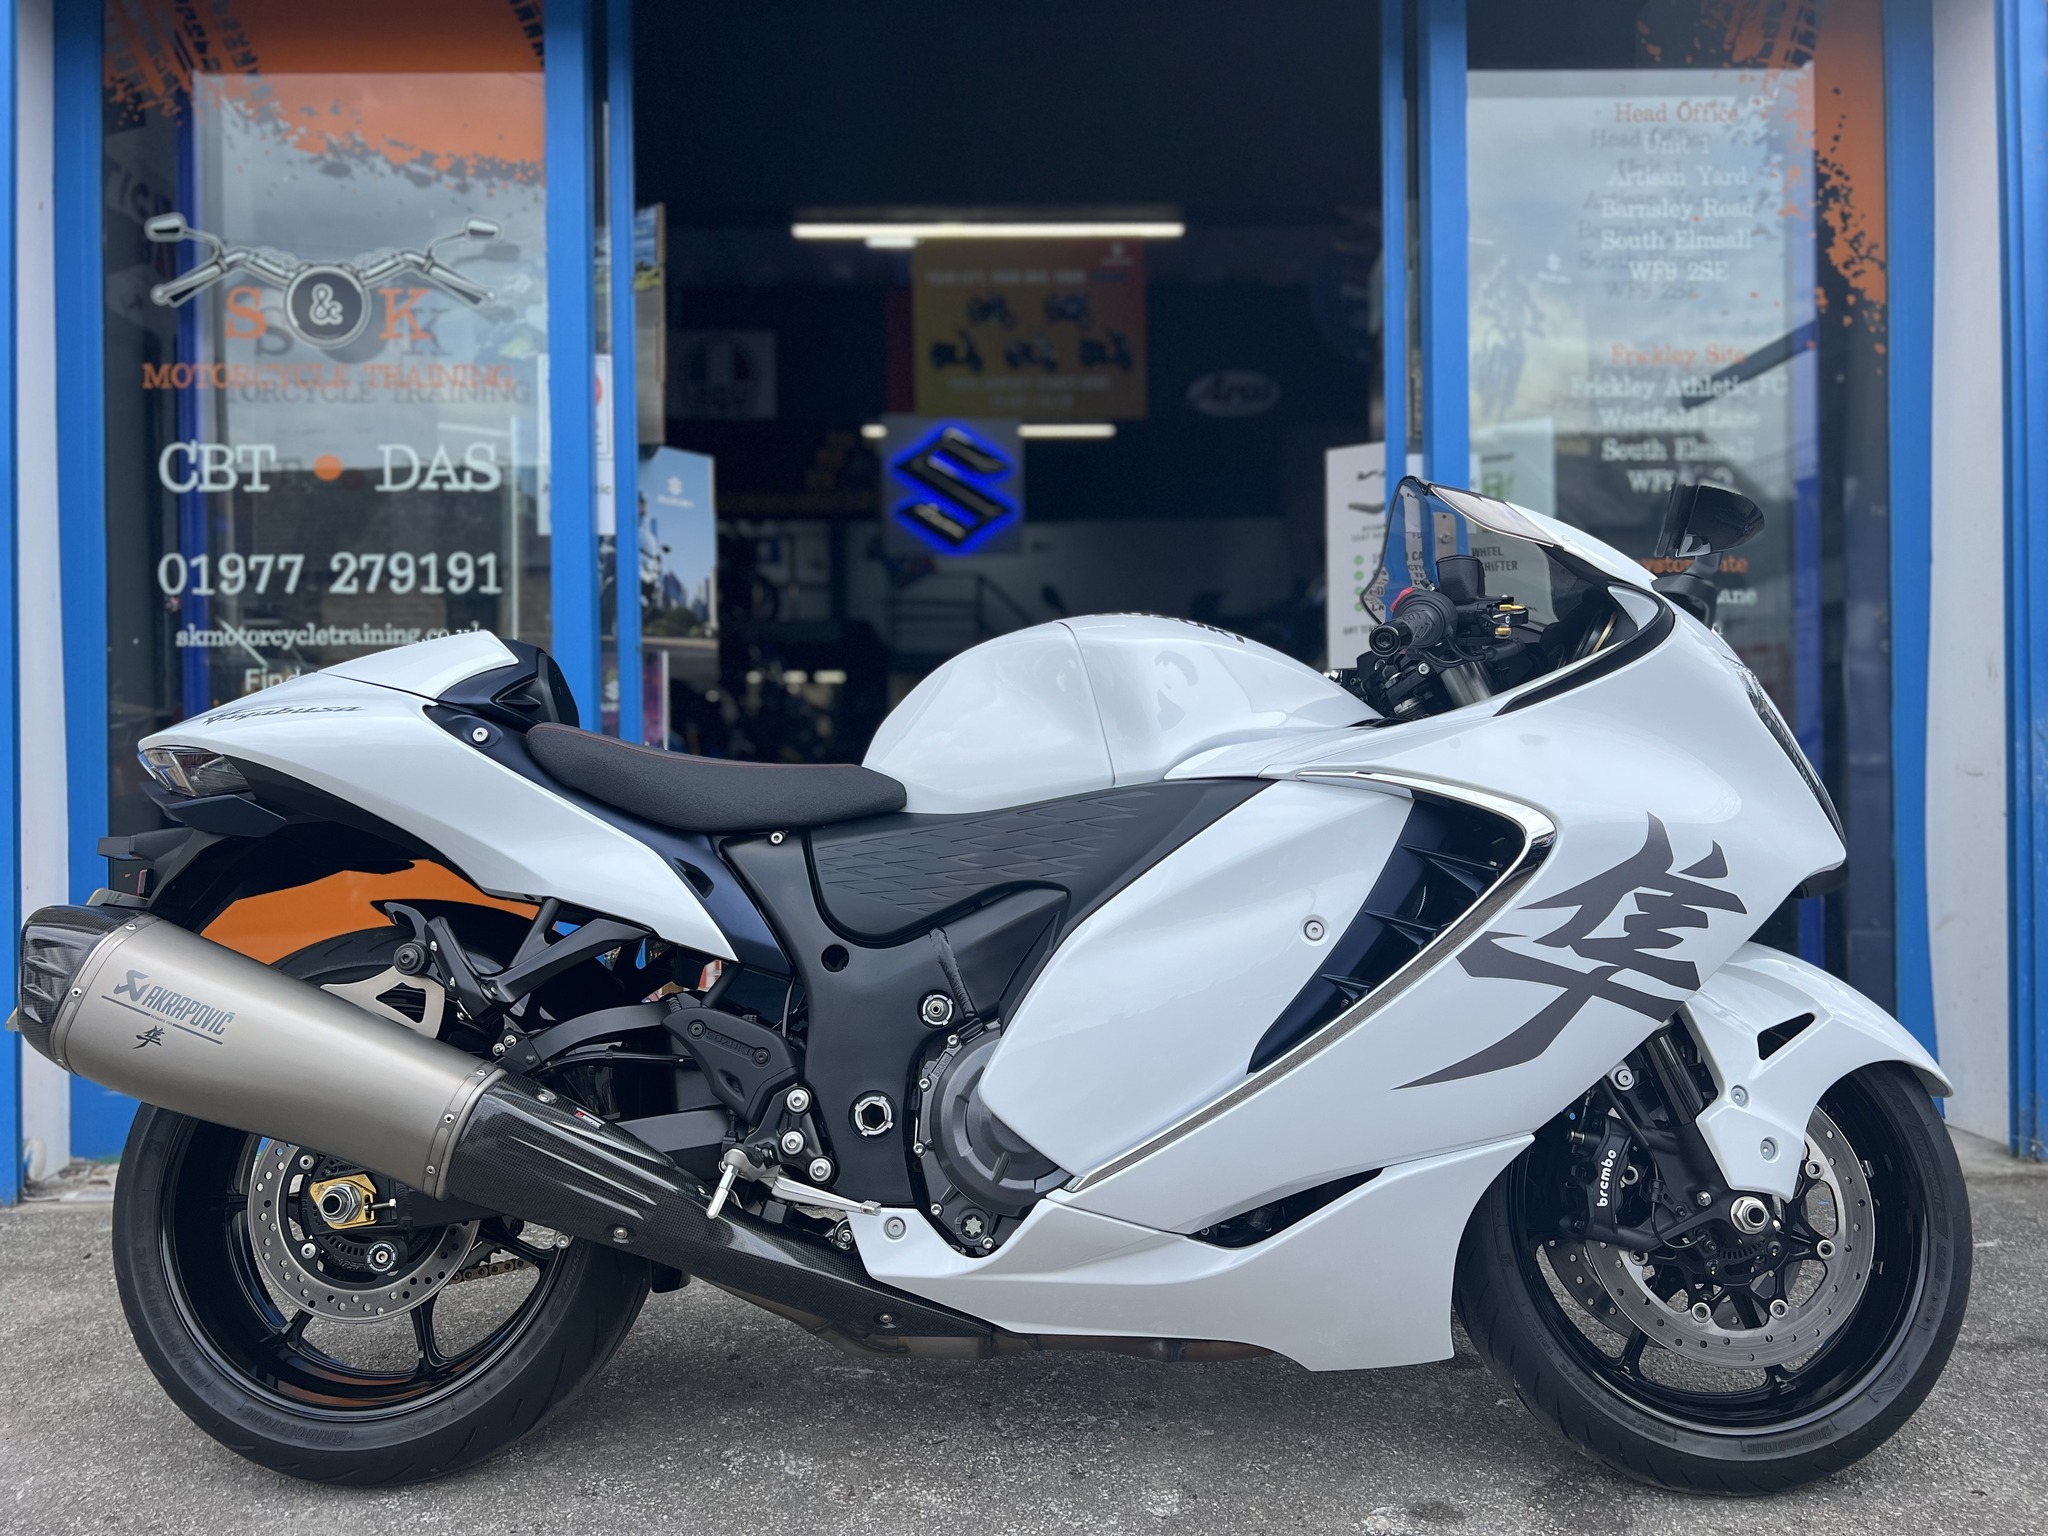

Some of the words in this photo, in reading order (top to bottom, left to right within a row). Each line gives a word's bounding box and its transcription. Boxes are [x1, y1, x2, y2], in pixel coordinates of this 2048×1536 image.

[1615, 103, 1668, 123] Head
[1676, 101, 1740, 123] Office
[1644, 133, 1690, 155] Unit
[1608, 166, 1687, 187] Artisan
[1696, 165, 1749, 186] Yard
[1601, 198, 1695, 222] Barnsley
[1702, 197, 1755, 219] Road
[1601, 229, 1665, 250] South
[1674, 228, 1753, 250] Elmsall
[1628, 260, 1678, 282] WF9
[1686, 260, 1730, 282] 2SE
[226, 286, 269, 341] S
[309, 283, 343, 326] &
[378, 288, 433, 341] K
[1611, 342, 1697, 368] Frickley
[1705, 342, 1747, 366] Site
[141, 362, 353, 390] MOTORCYCLE
[361, 362, 515, 390] TRAINING
[1571, 374, 1656, 399] Frickley
[1665, 374, 1750, 398] Athletic
[1600, 405, 1699, 429] Westfield
[1707, 407, 1761, 429] Lane
[1601, 436, 1669, 462] South
[158, 440, 278, 493] CBT
[375, 441, 502, 493] DAS
[1471, 547, 1504, 558] WHEEL
[158, 551, 305, 596] 01977
[329, 551, 503, 596] 279191
[1596, 1149, 1617, 1208] brembo
